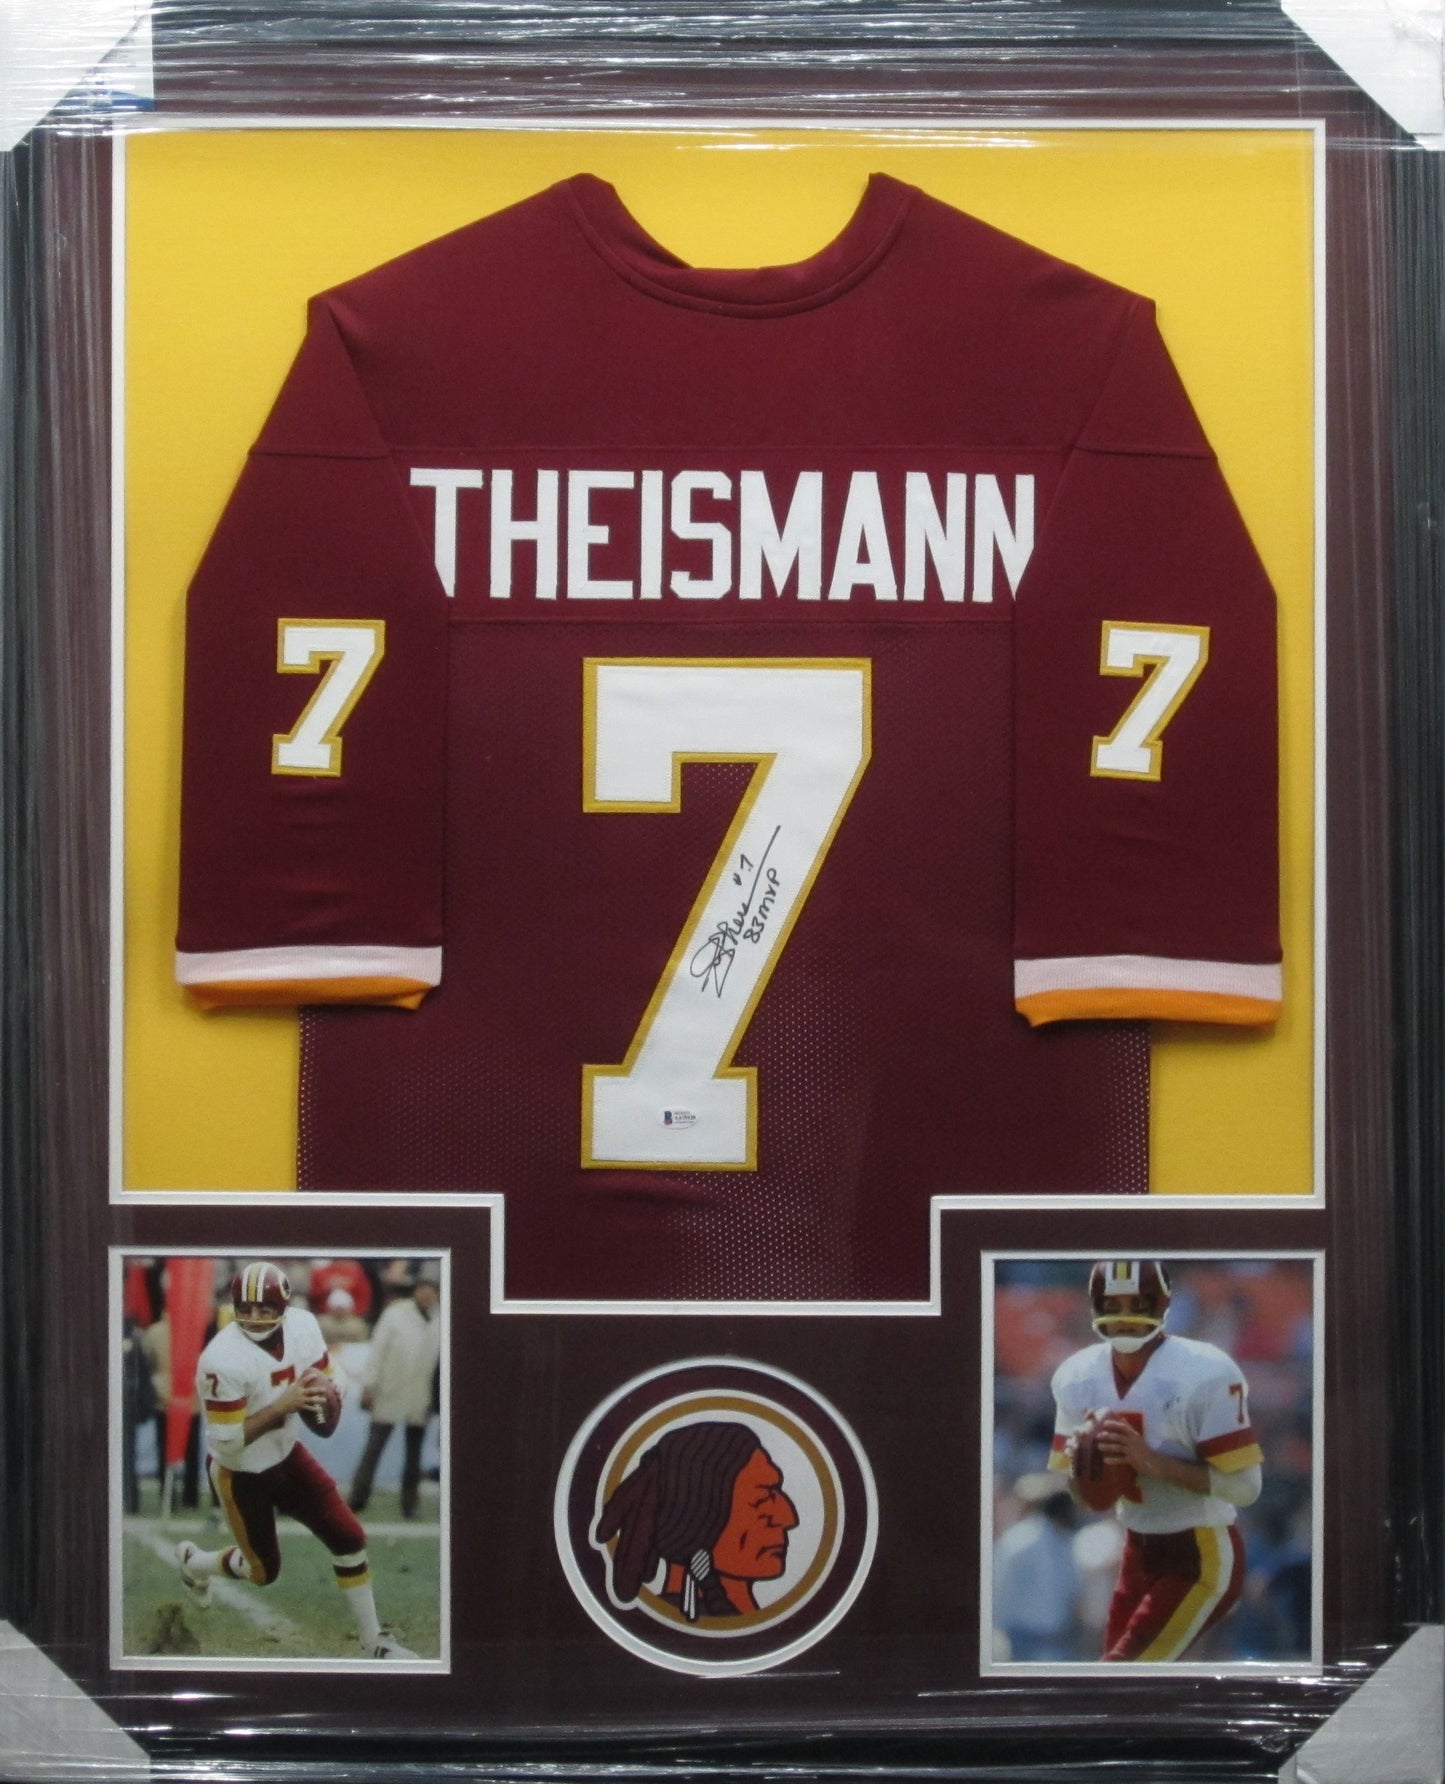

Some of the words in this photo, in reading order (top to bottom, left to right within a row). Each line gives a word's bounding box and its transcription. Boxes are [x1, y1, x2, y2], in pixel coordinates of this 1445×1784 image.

[409, 467, 1035, 603] THEISMANN
[271, 617, 386, 777] 7
[1090, 620, 1211, 782] 7
[582, 657, 873, 1171] 7
[206, 1374, 218, 1397] 7
[1229, 1384, 1245, 1424] 7
